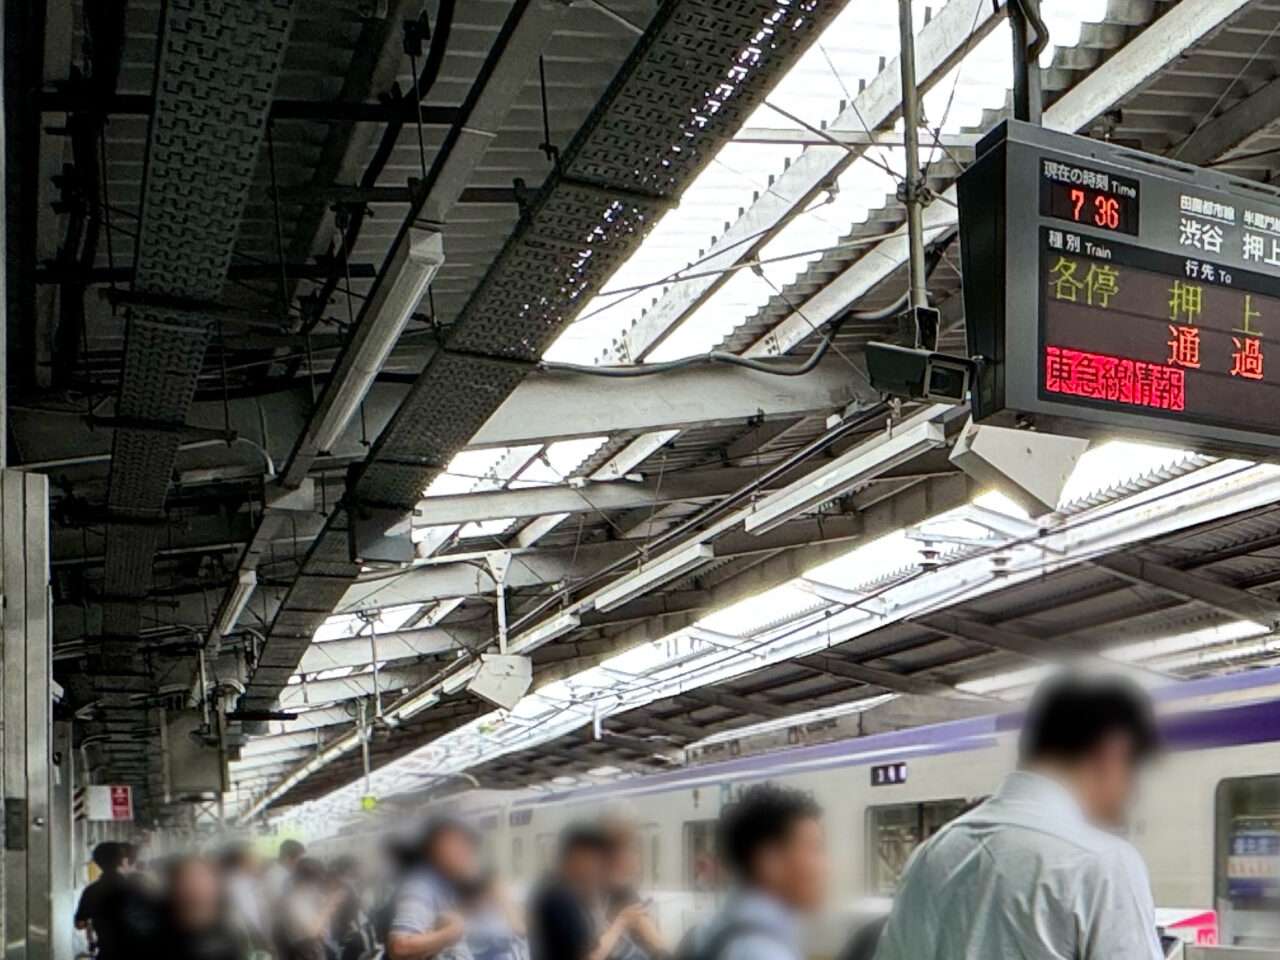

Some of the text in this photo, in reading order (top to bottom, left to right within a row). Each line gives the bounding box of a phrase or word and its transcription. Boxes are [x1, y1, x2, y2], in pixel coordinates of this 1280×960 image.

[1043, 160, 1137, 199] 現在の時刻 Time
[1071, 189, 1120, 230] 7 36
[1049, 230, 1112, 260] 種別 Train
[1179, 217, 1224, 254] 渋谷
[1049, 256, 1120, 309] 各停
[1185, 259, 1232, 284] 行先 To
[1046, 347, 1185, 411] 東急線情報
